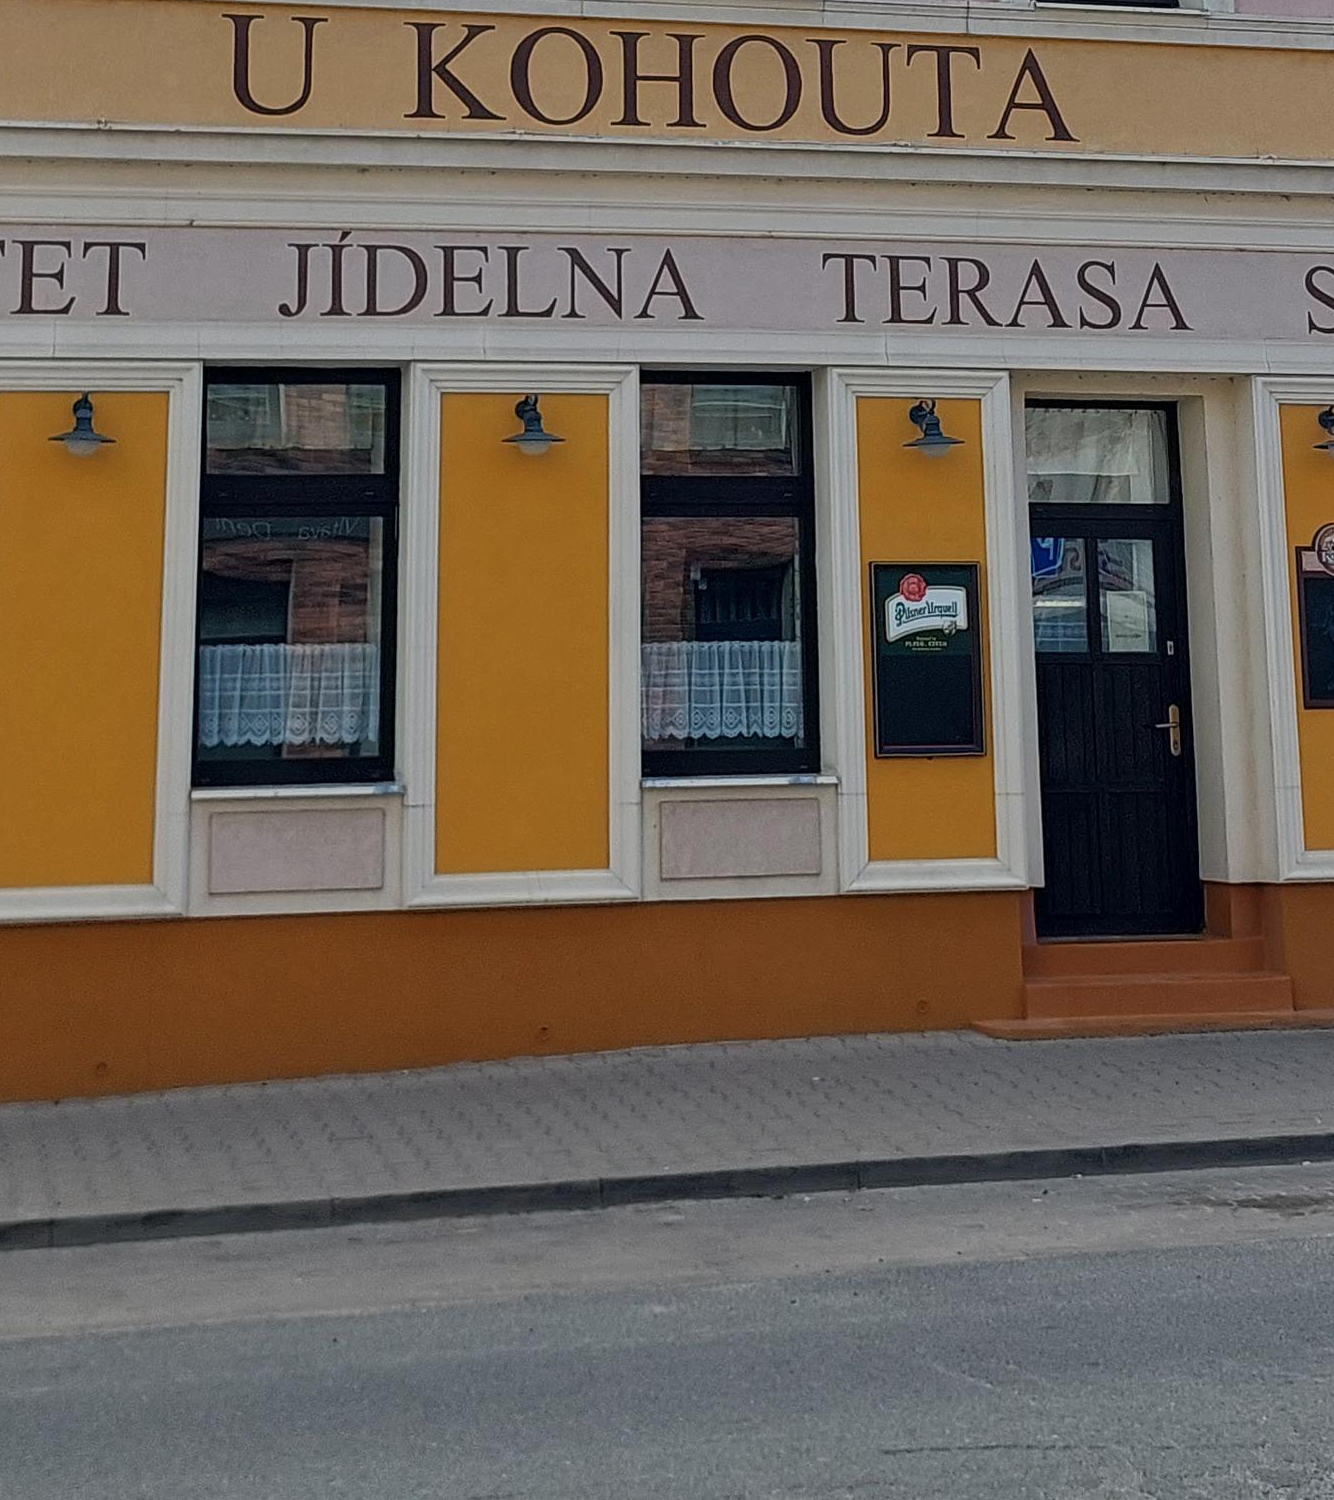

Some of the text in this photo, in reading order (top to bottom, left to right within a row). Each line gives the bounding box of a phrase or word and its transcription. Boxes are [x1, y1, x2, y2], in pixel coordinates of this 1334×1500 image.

[222, 13, 1081, 144] U KOHOUTA
[278, 231, 705, 322] JÍDELNA
[822, 252, 1195, 332] TERASA
[895, 601, 958, 627] Pilsner Urquell
